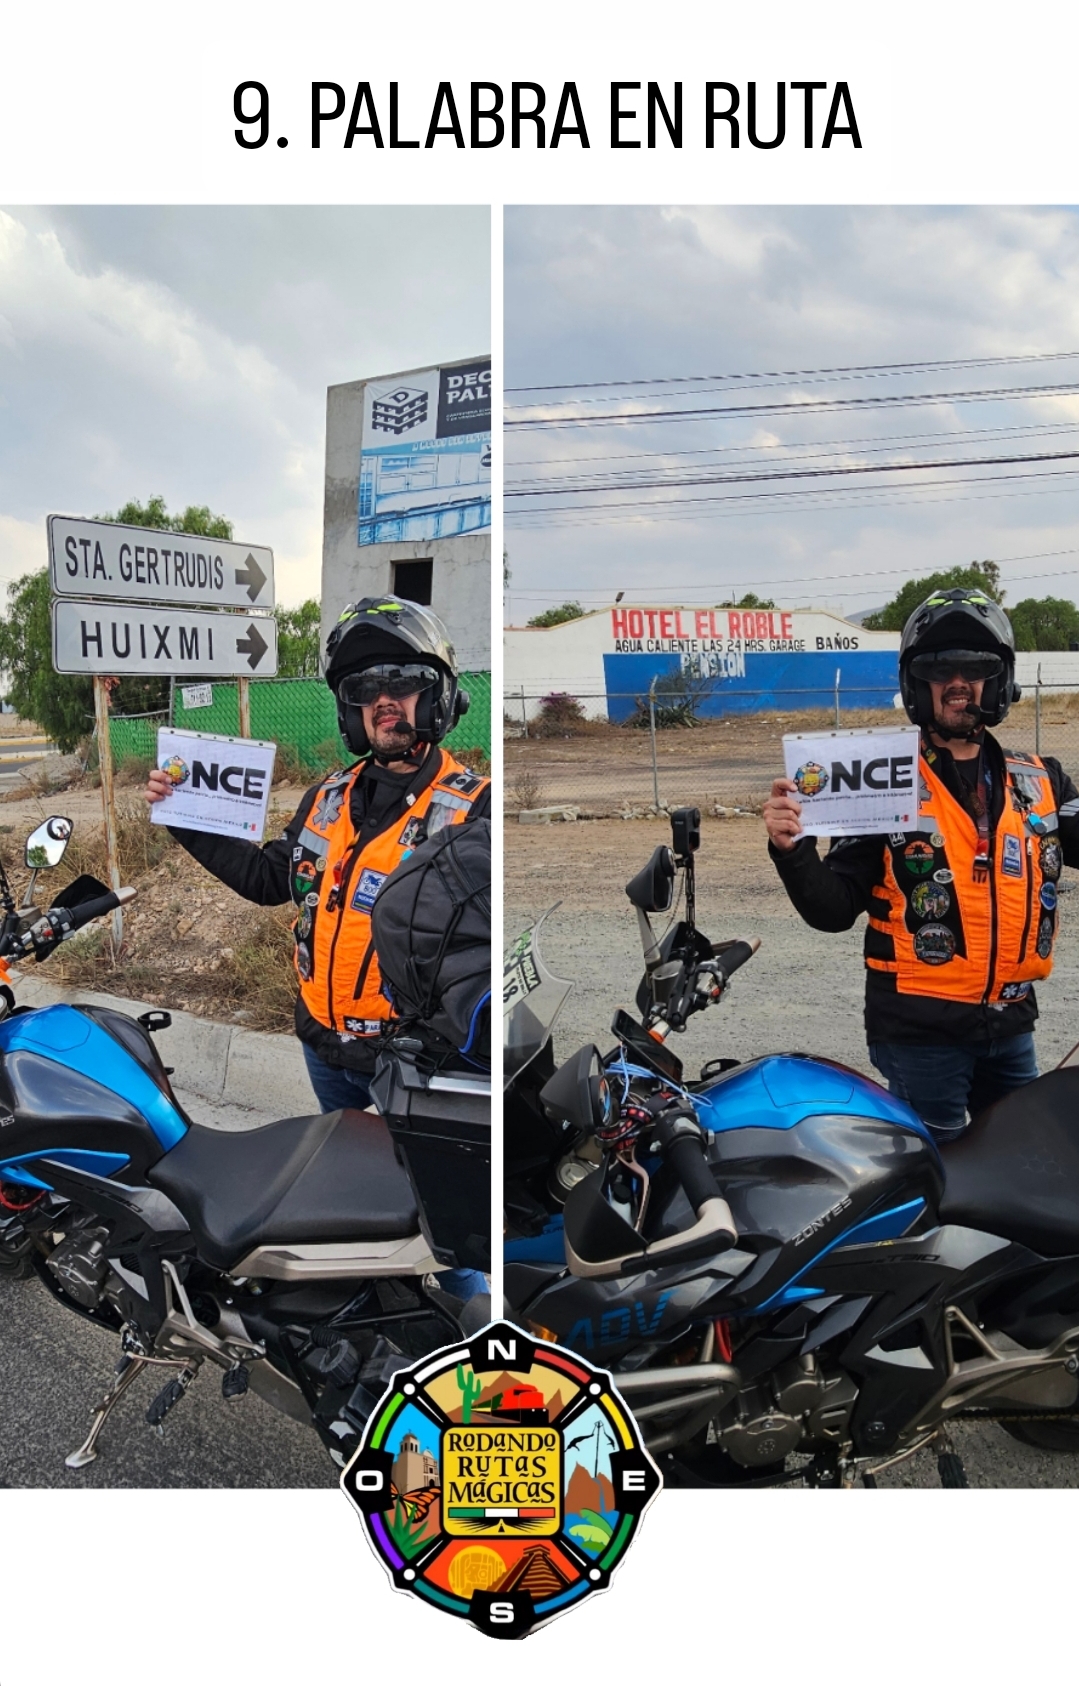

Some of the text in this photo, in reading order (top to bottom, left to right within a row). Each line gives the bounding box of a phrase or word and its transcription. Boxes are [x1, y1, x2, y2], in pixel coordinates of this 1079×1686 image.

[65, 536, 224, 590] STA. GERTRUDIS
[80, 620, 214, 661] HUIXMI
[611, 609, 793, 640] HOTEL EL ROBLE
[816, 633, 860, 651] BAÑOS
[615, 639, 644, 653] AGUA
[647, 639, 699, 653] CALIENTE
[702, 639, 723, 653] LAS
[727, 639, 743, 653] 24
[769, 639, 806, 652] GARAGE
[791, 1195, 853, 1247] ZONTES
